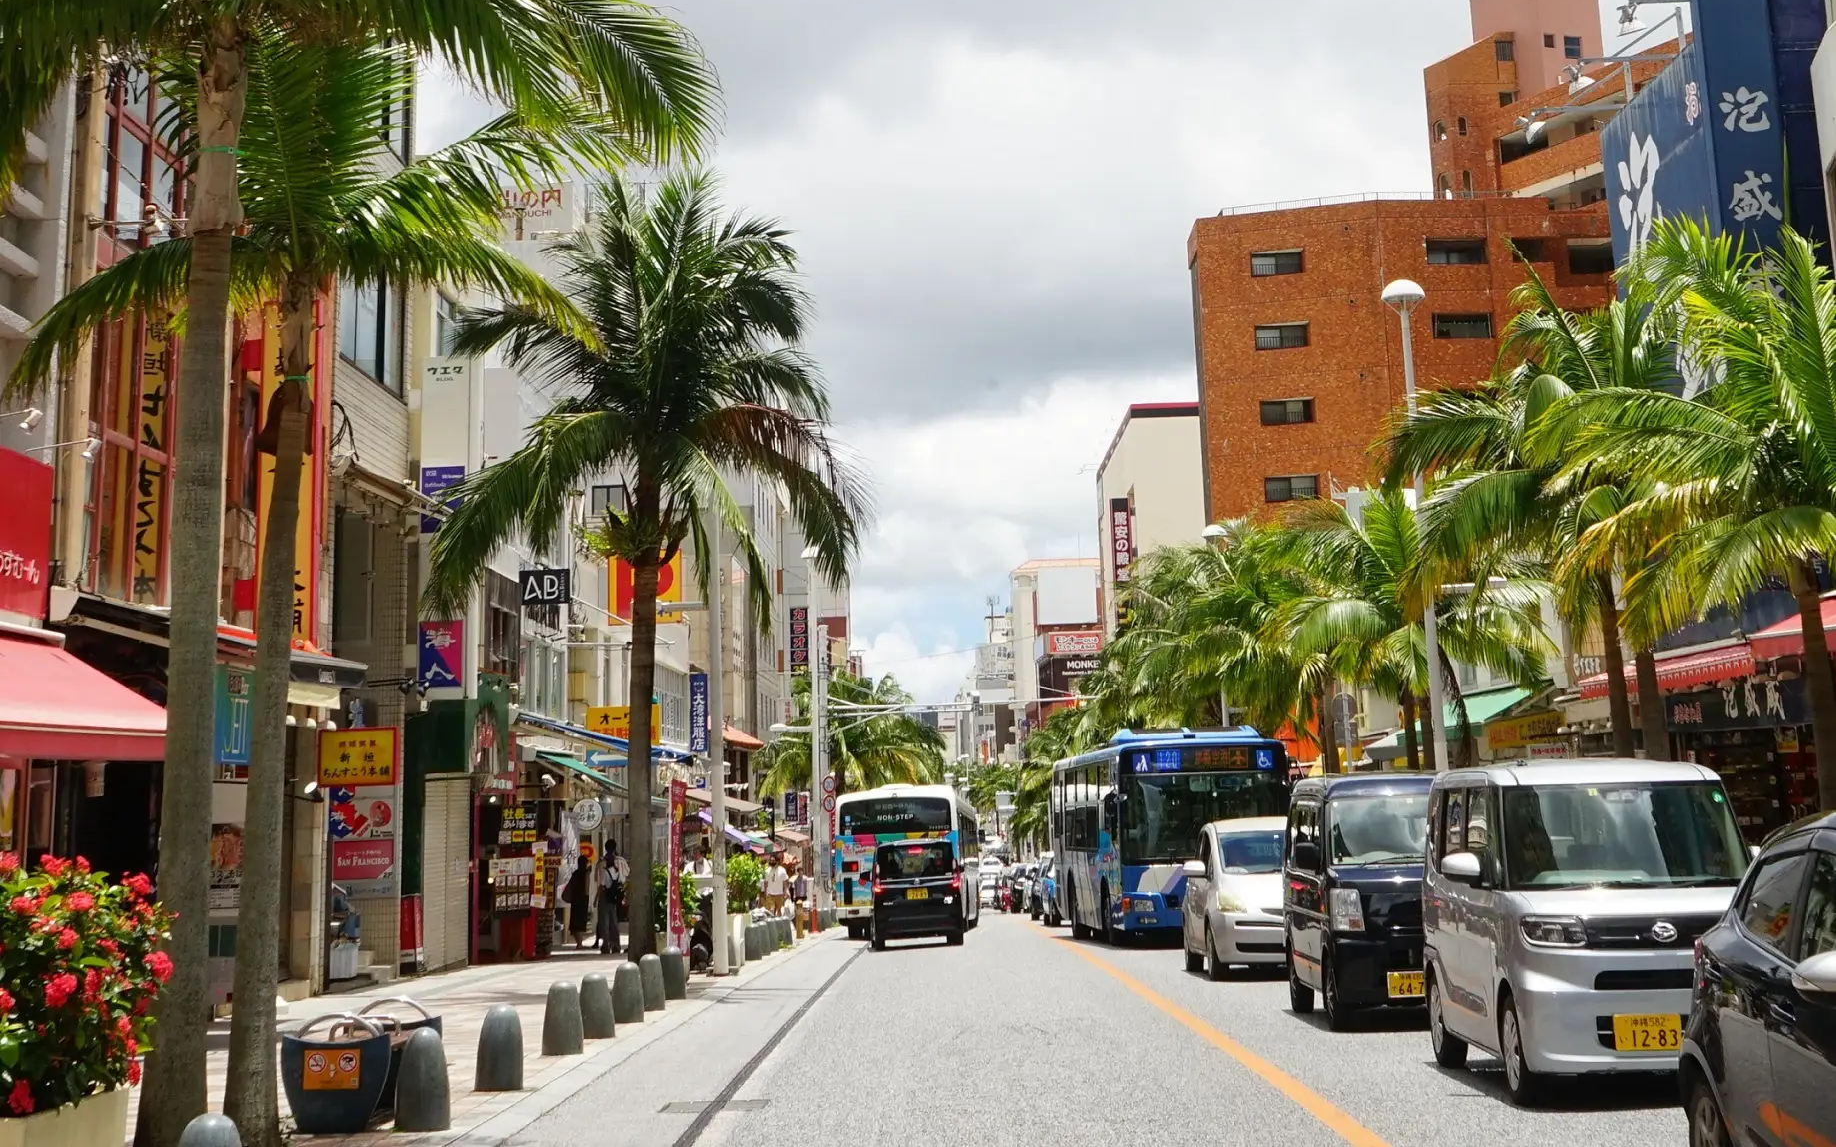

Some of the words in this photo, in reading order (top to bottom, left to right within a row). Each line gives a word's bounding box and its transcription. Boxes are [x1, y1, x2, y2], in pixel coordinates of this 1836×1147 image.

[793, 609, 806, 662] カラオケ
[877, 813, 914, 821] NON-STEP
[503, 820, 535, 829] あります
[353, 855, 390, 866] FRANCISCO
[1632, 1029, 1678, 1047] 12-83
